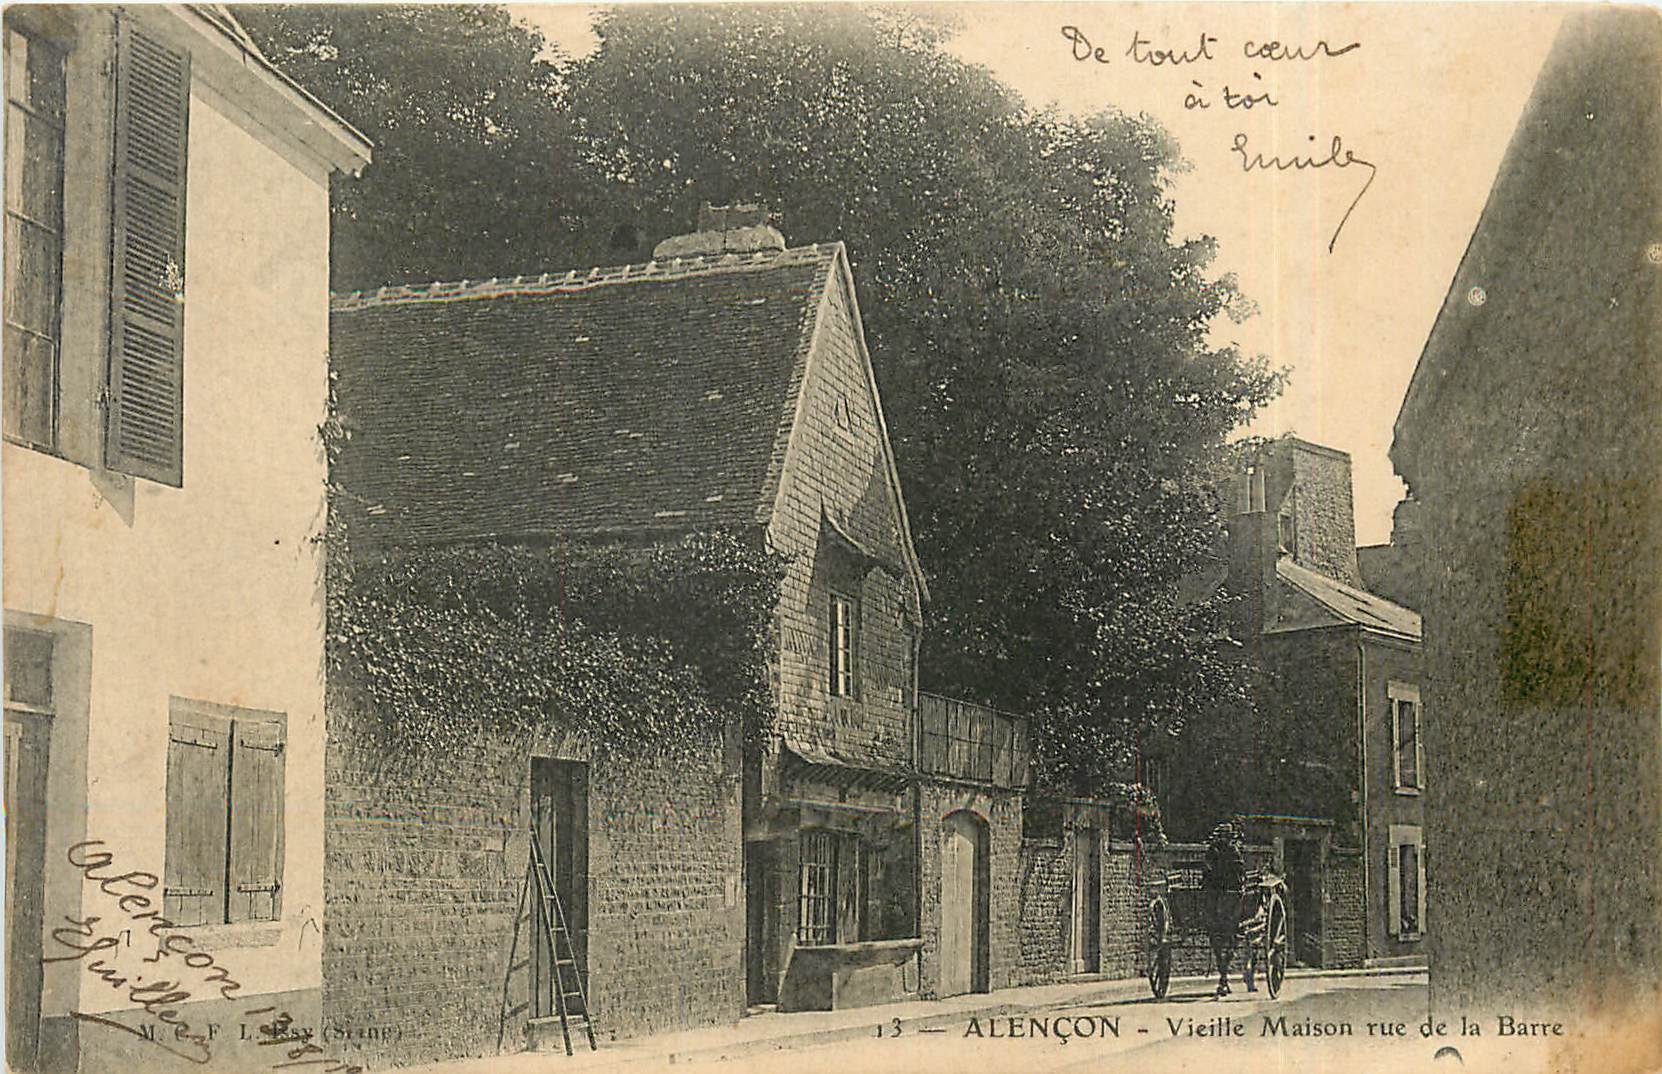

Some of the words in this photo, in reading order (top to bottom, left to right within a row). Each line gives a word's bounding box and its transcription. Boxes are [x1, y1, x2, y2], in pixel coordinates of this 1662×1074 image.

[1062, 26, 1109, 63] De
[1126, 30, 1218, 66] tout
[1185, 80, 1210, 109] à
[1223, 72, 1279, 109] toi
